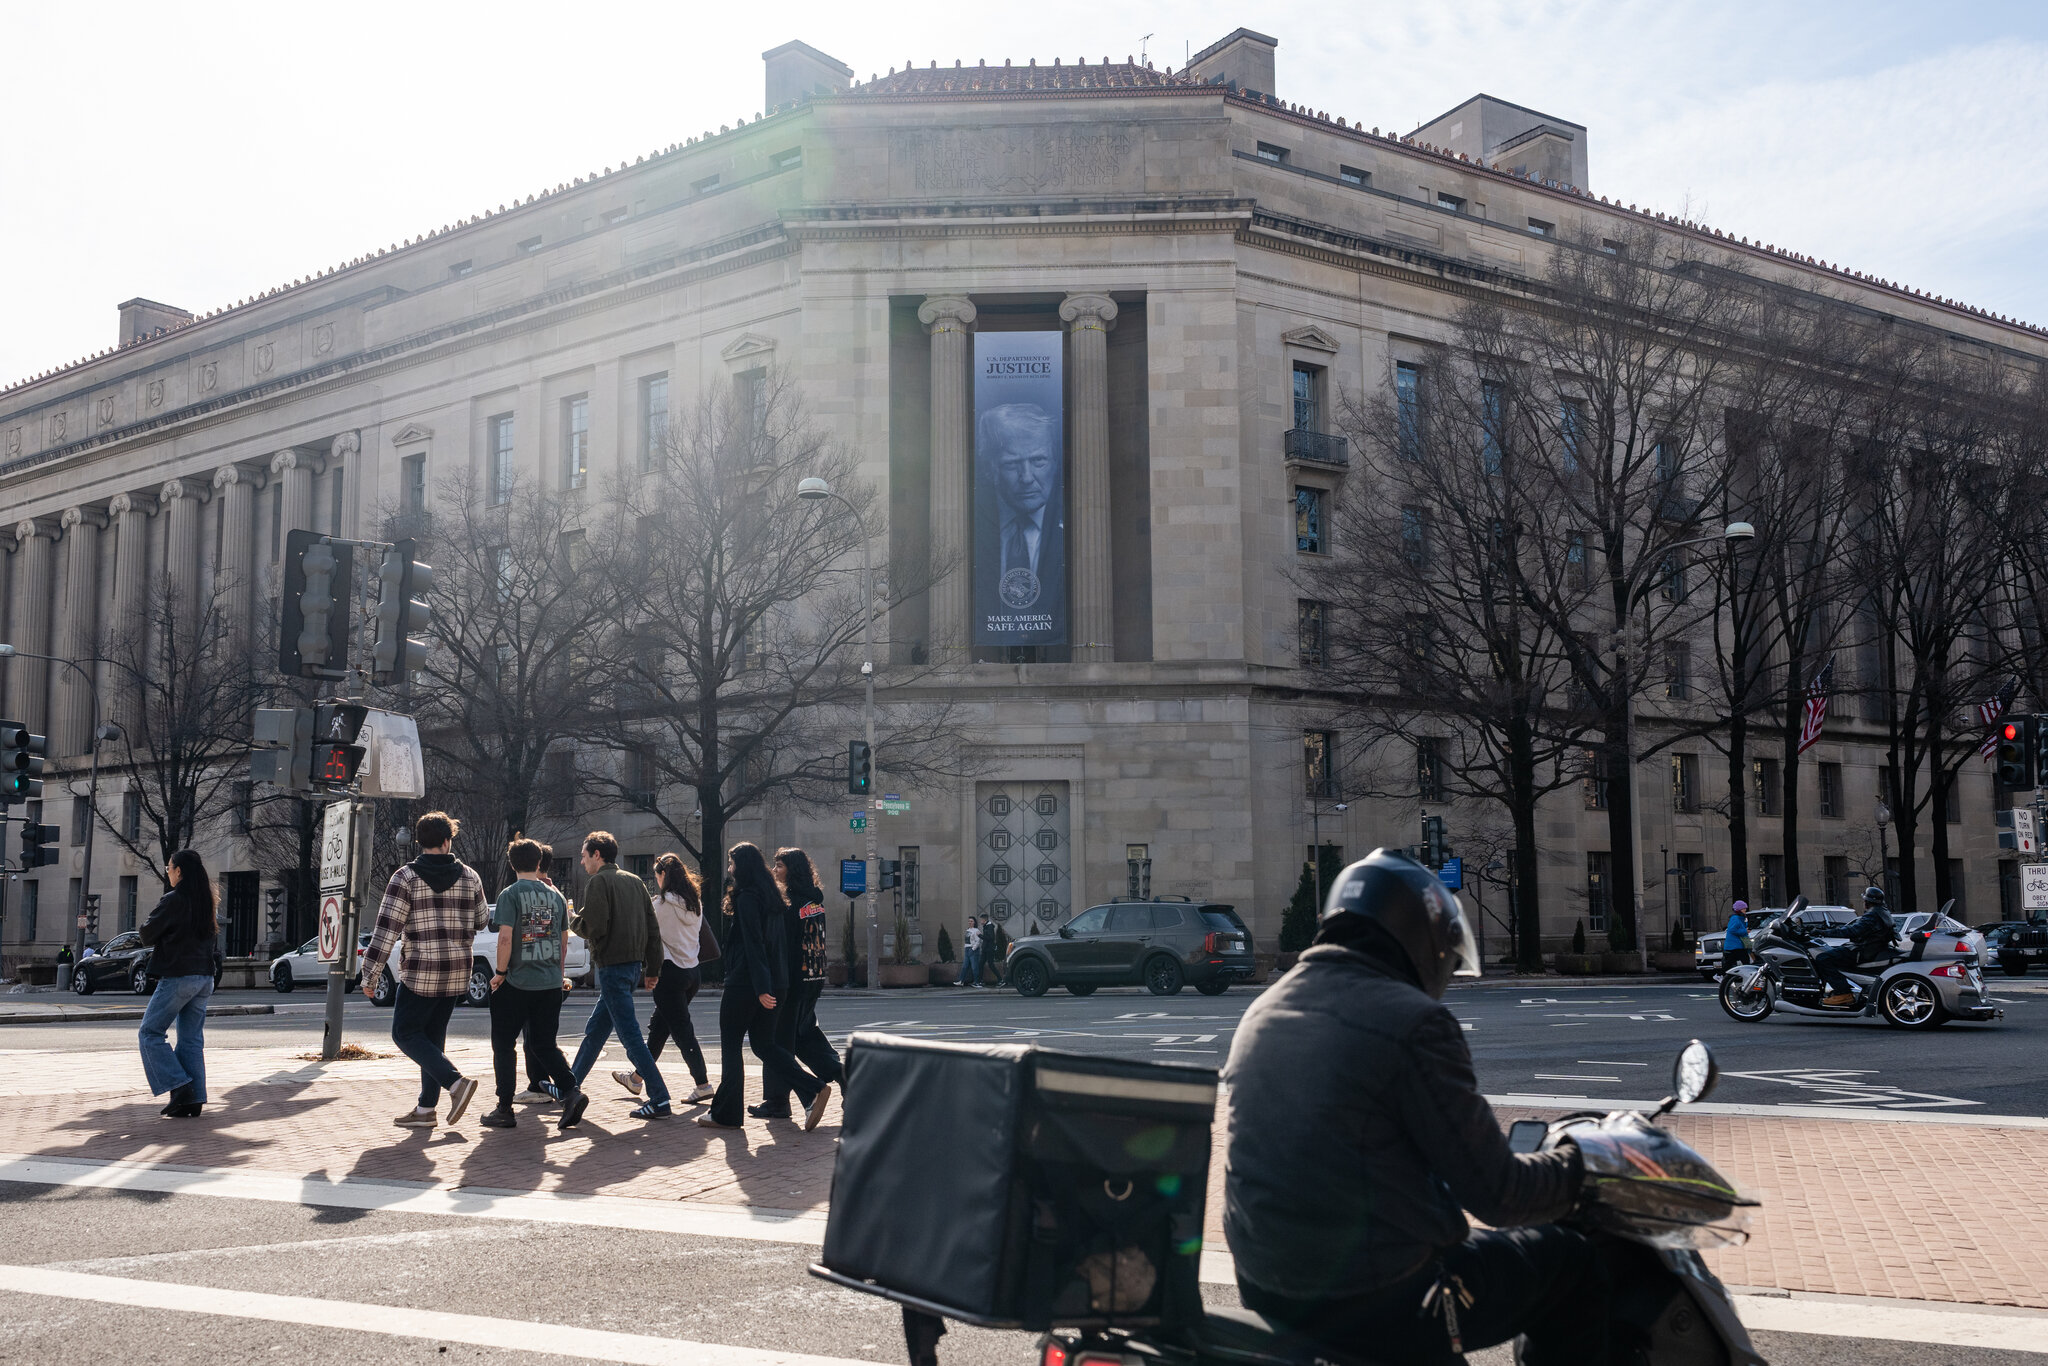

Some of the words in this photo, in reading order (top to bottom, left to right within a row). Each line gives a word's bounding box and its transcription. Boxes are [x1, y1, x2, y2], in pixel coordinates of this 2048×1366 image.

[1058, 136, 1116, 146] FOUNDED
[1119, 135, 1131, 145] IN
[934, 159, 980, 169] NATURE
[930, 179, 982, 190] SECURITY
[1073, 175, 1118, 186] JUSTICE
[987, 362, 1051, 374] JUSTICE
[987, 623, 1015, 631] SAFE
[1017, 622, 1053, 631] AGAIN
[2019, 811, 2028, 821] NO
[2019, 821, 2030, 830] TURN
[2018, 830, 2024, 839] ON
[2025, 831, 2033, 839] RED
[2028, 867, 2047, 876] THRU
[520, 890, 559, 914] HOOK
